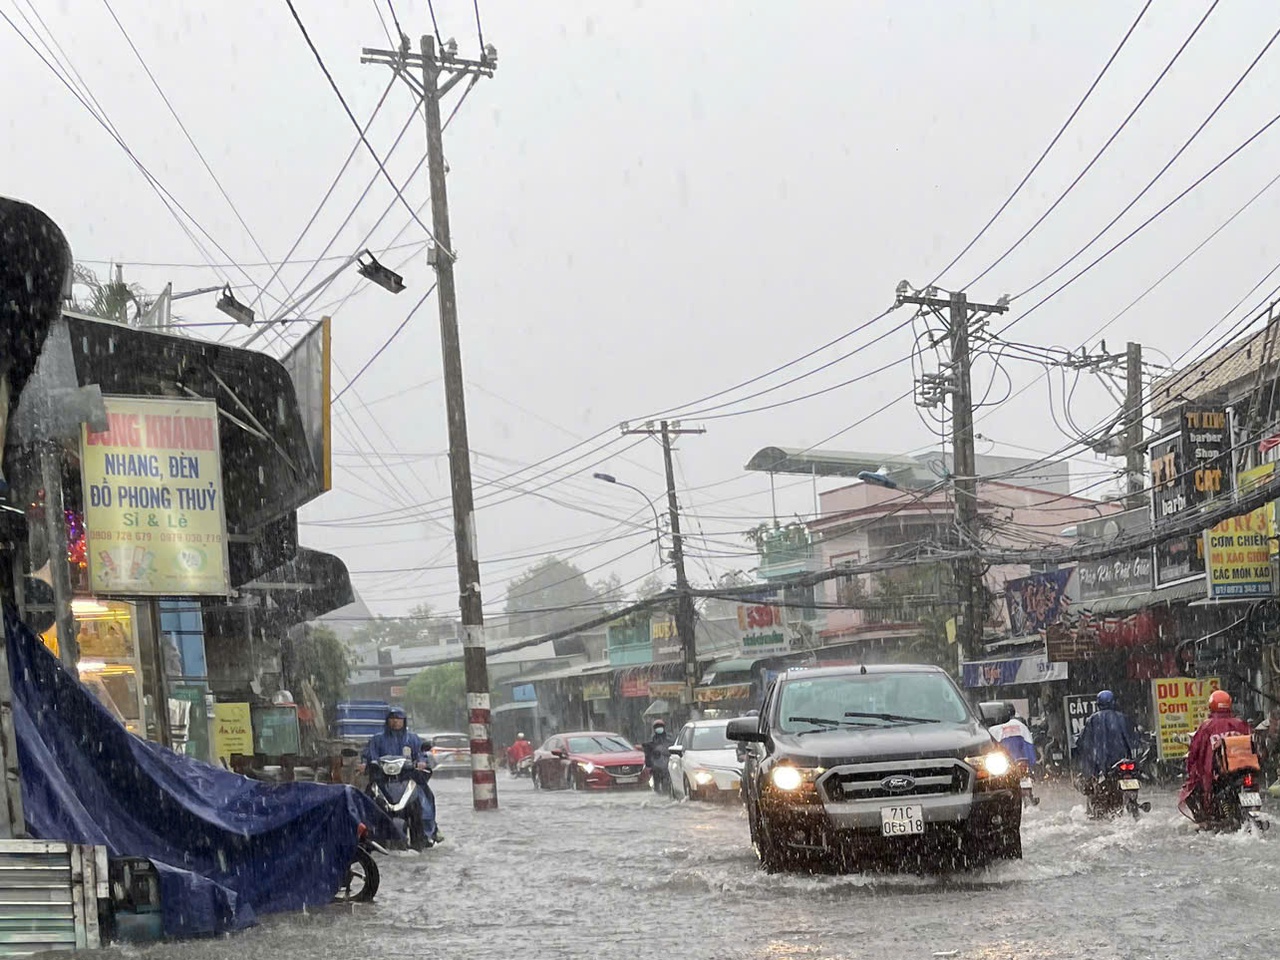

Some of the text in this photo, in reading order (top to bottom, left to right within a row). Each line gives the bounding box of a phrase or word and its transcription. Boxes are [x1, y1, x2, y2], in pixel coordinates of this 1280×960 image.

[146, 409, 215, 451] KHÁNH
[1190, 433, 1222, 442] barber
[1195, 448, 1219, 460] Shop
[104, 452, 199, 482] NHANG, ĐÈN
[90, 478, 112, 507] ĐỒ
[118, 486, 171, 509] PHONG
[147, 514, 159, 527] &
[889, 778, 908, 787] Ford
[890, 807, 913, 820] 71C
